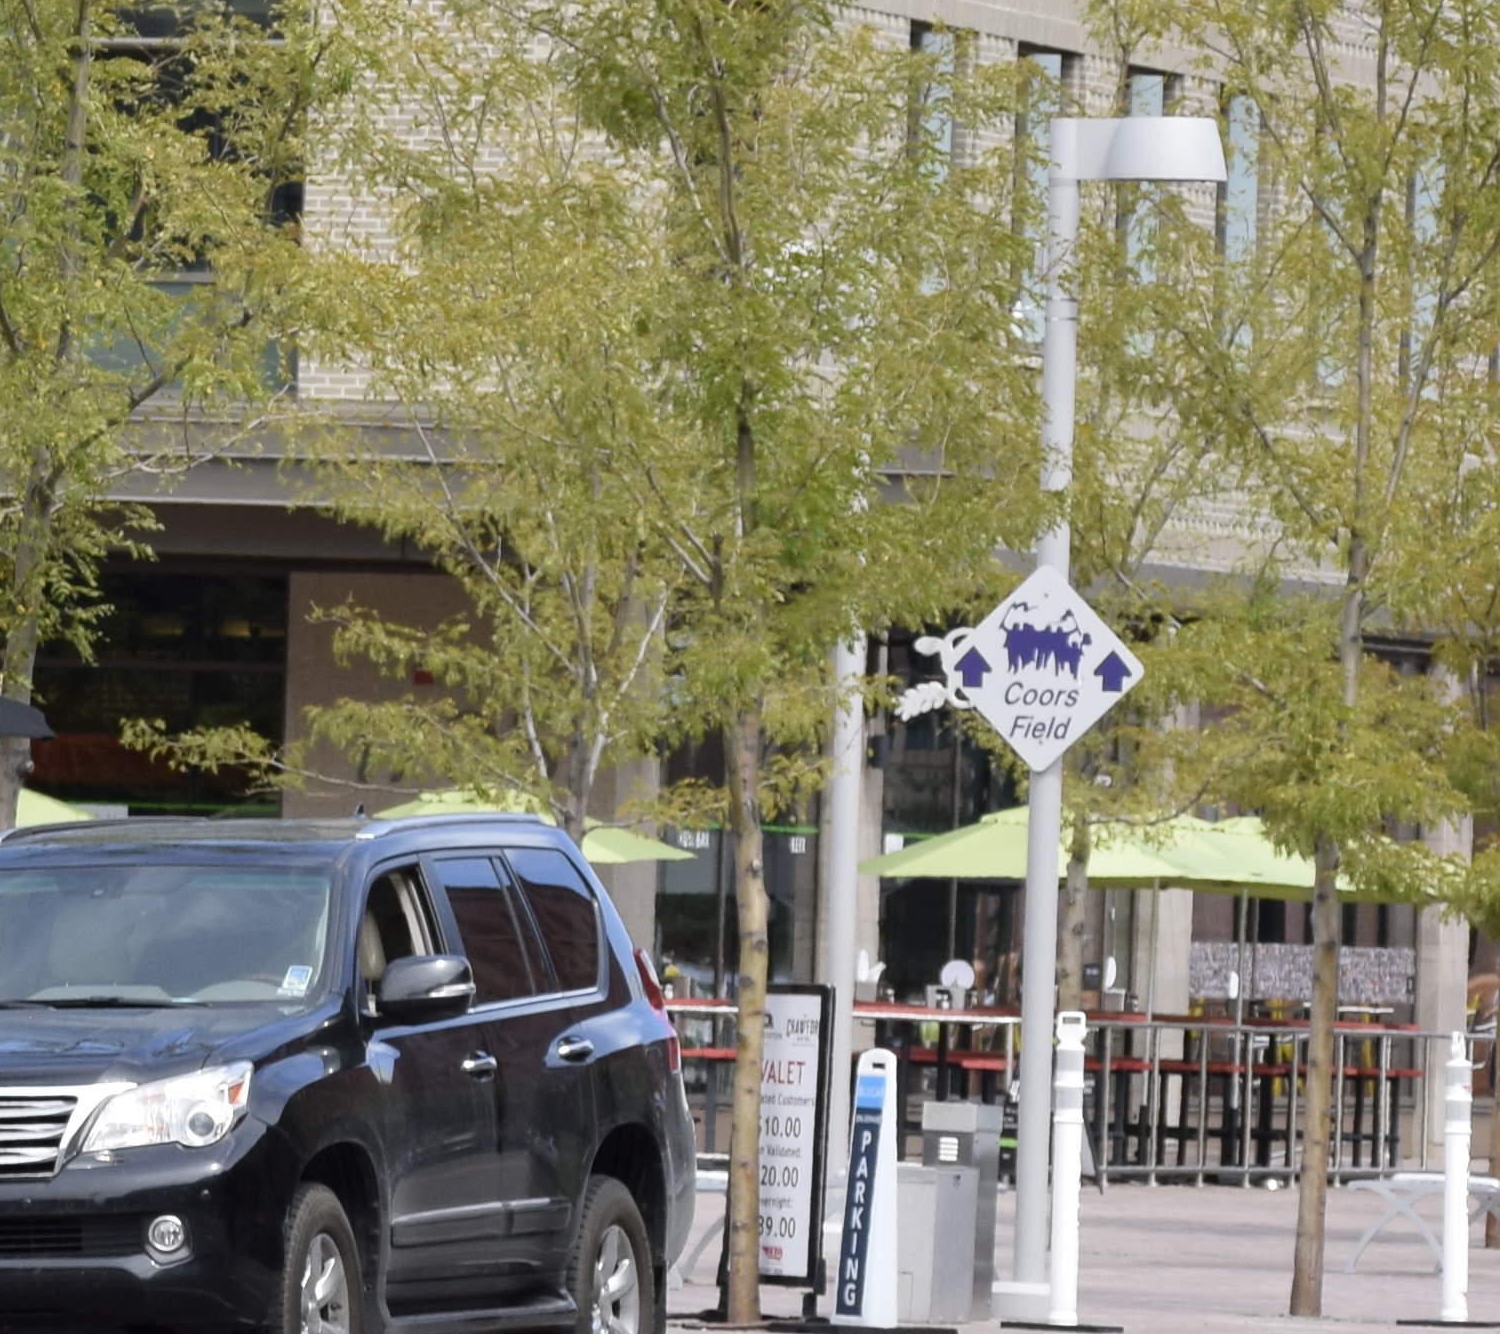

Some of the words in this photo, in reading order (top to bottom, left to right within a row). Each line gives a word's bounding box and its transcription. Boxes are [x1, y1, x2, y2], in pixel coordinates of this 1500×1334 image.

[1003, 681, 1080, 708] Coors
[1009, 715, 1072, 740] Field
[786, 1018, 819, 1038] CRAWFOR
[760, 1116, 802, 1138] 10.00
[843, 1130, 872, 1306] PARKING
